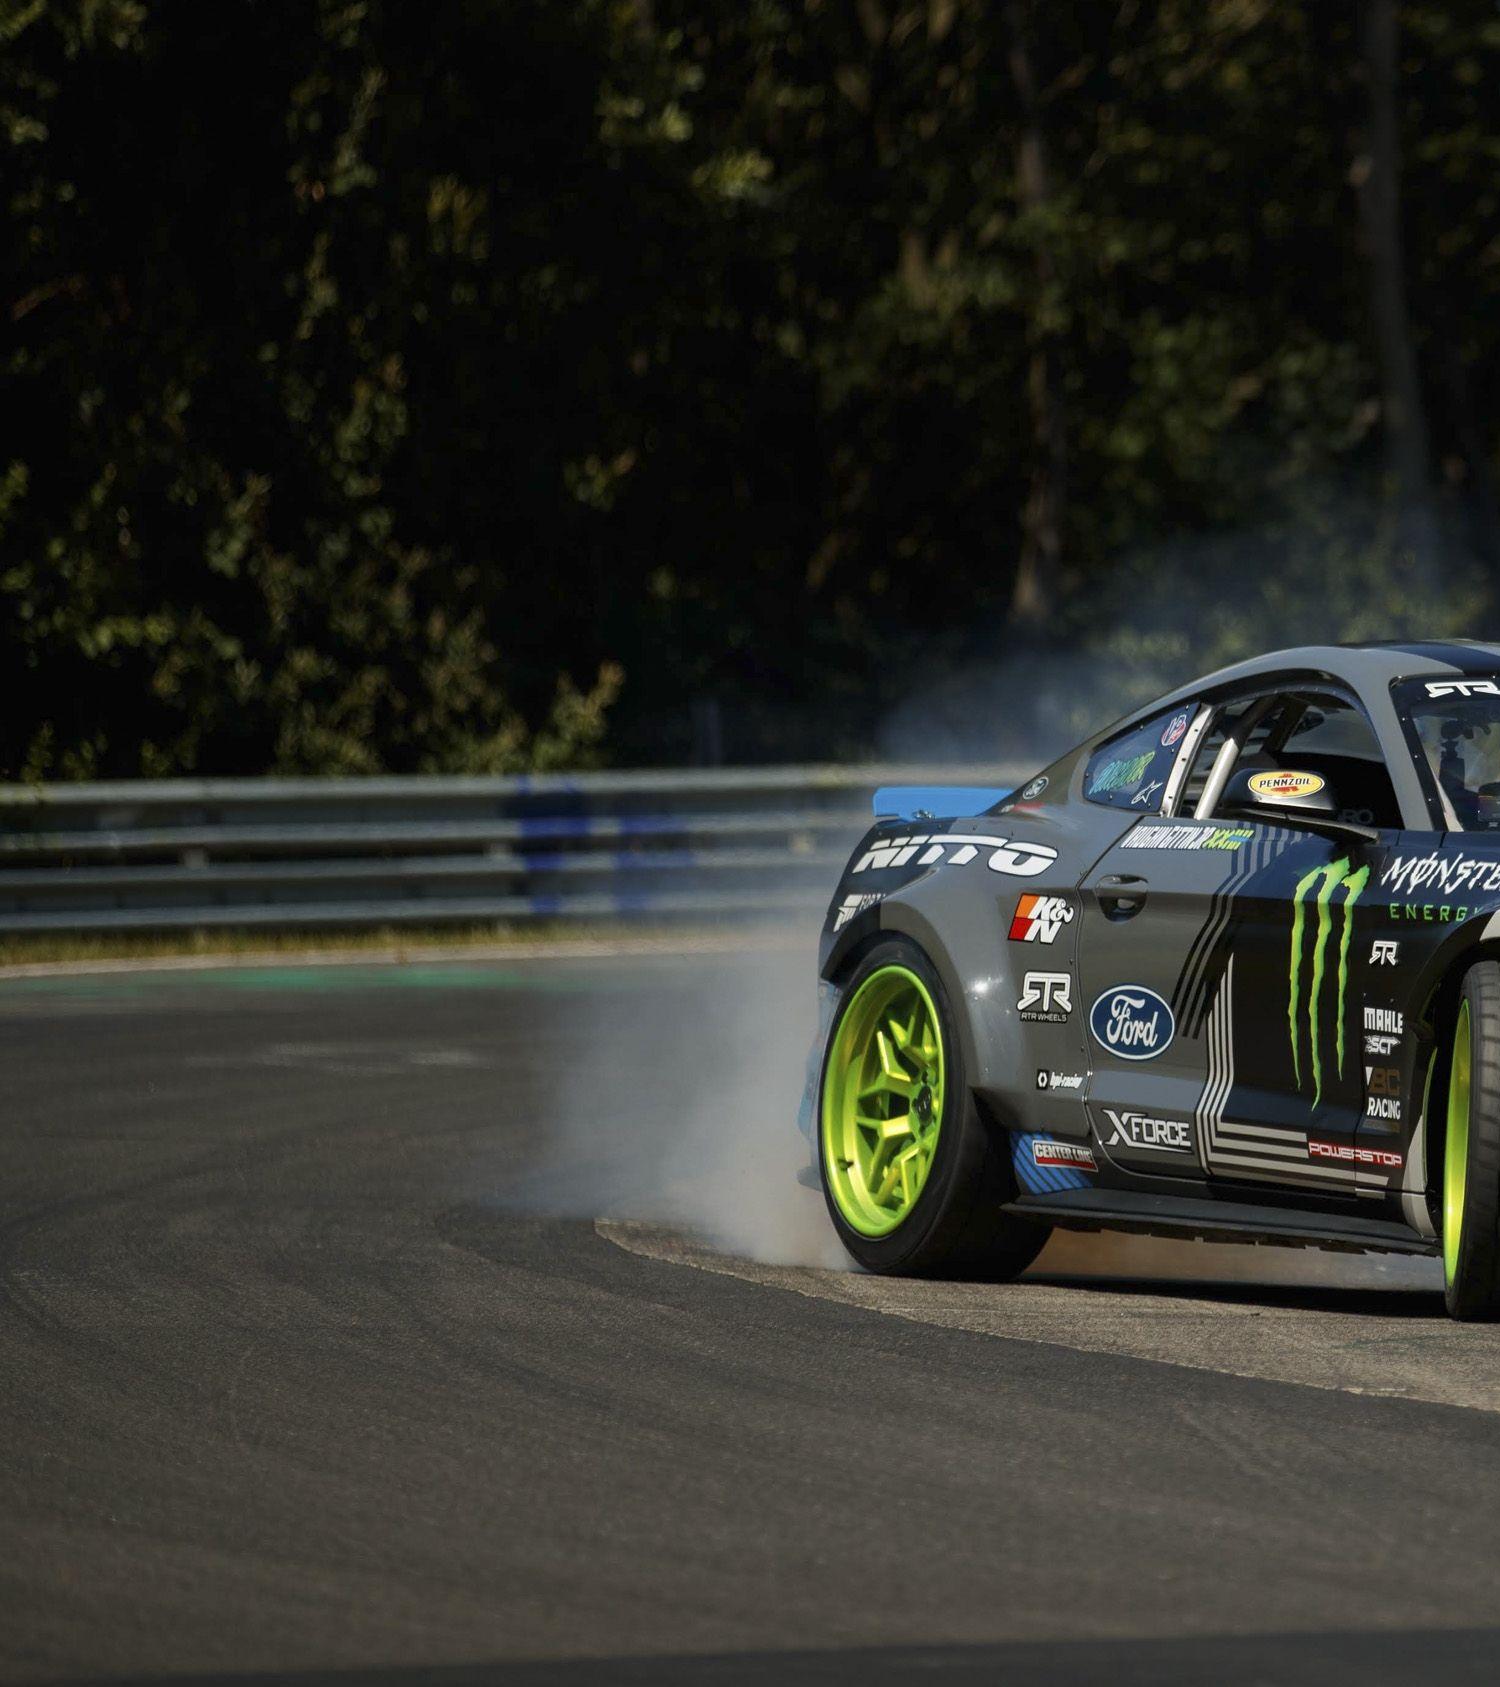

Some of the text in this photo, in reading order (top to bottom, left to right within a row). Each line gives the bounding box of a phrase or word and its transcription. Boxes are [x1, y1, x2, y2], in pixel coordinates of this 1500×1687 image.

[1259, 777, 1311, 788] PENNZOIL
[852, 834, 1058, 877] NITTO
[1038, 1013, 1067, 1022] WHEELS
[1106, 994, 1158, 1048] Ford
[1364, 1007, 1403, 1034] MAHLE
[1366, 1097, 1400, 1120] RACING
[1035, 1144, 1073, 1160] CENTER
